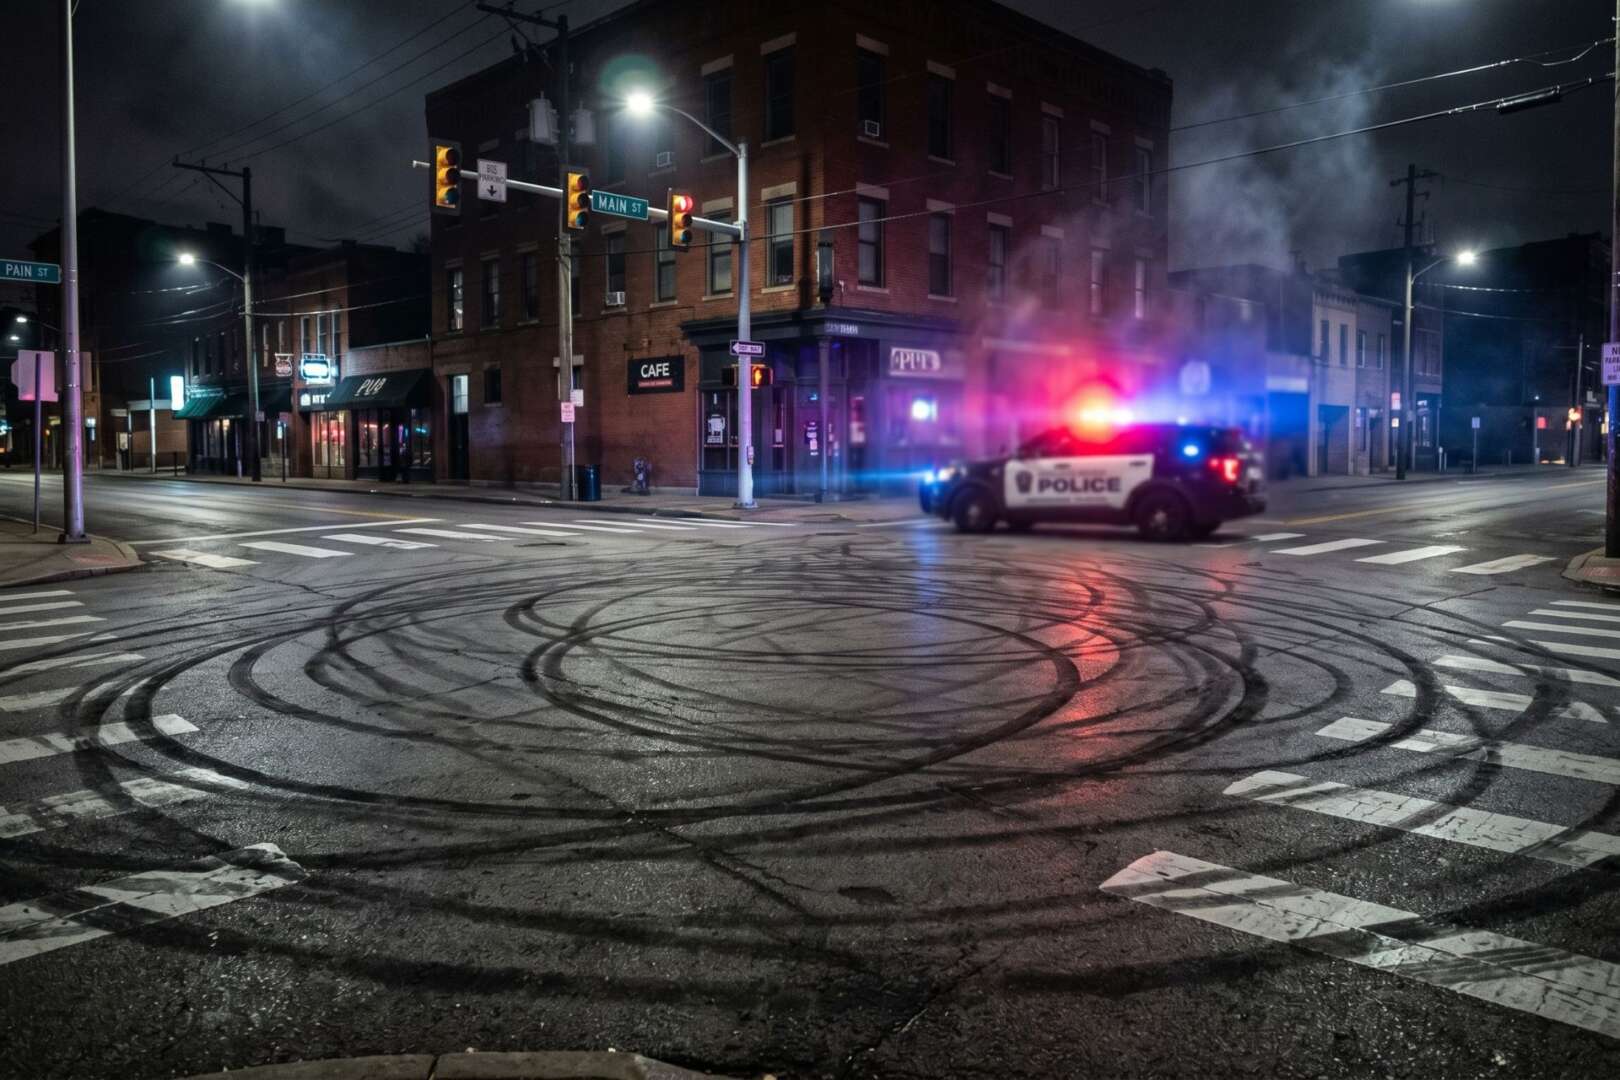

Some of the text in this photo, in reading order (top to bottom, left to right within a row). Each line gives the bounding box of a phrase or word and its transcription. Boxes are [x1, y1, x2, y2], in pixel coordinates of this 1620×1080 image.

[599, 195, 641, 213] MAIN ST
[6, 263, 48, 278] PAIN ST
[641, 362, 670, 378] CAFE
[355, 377, 387, 396] PUB
[1038, 477, 1121, 493] POLICE
